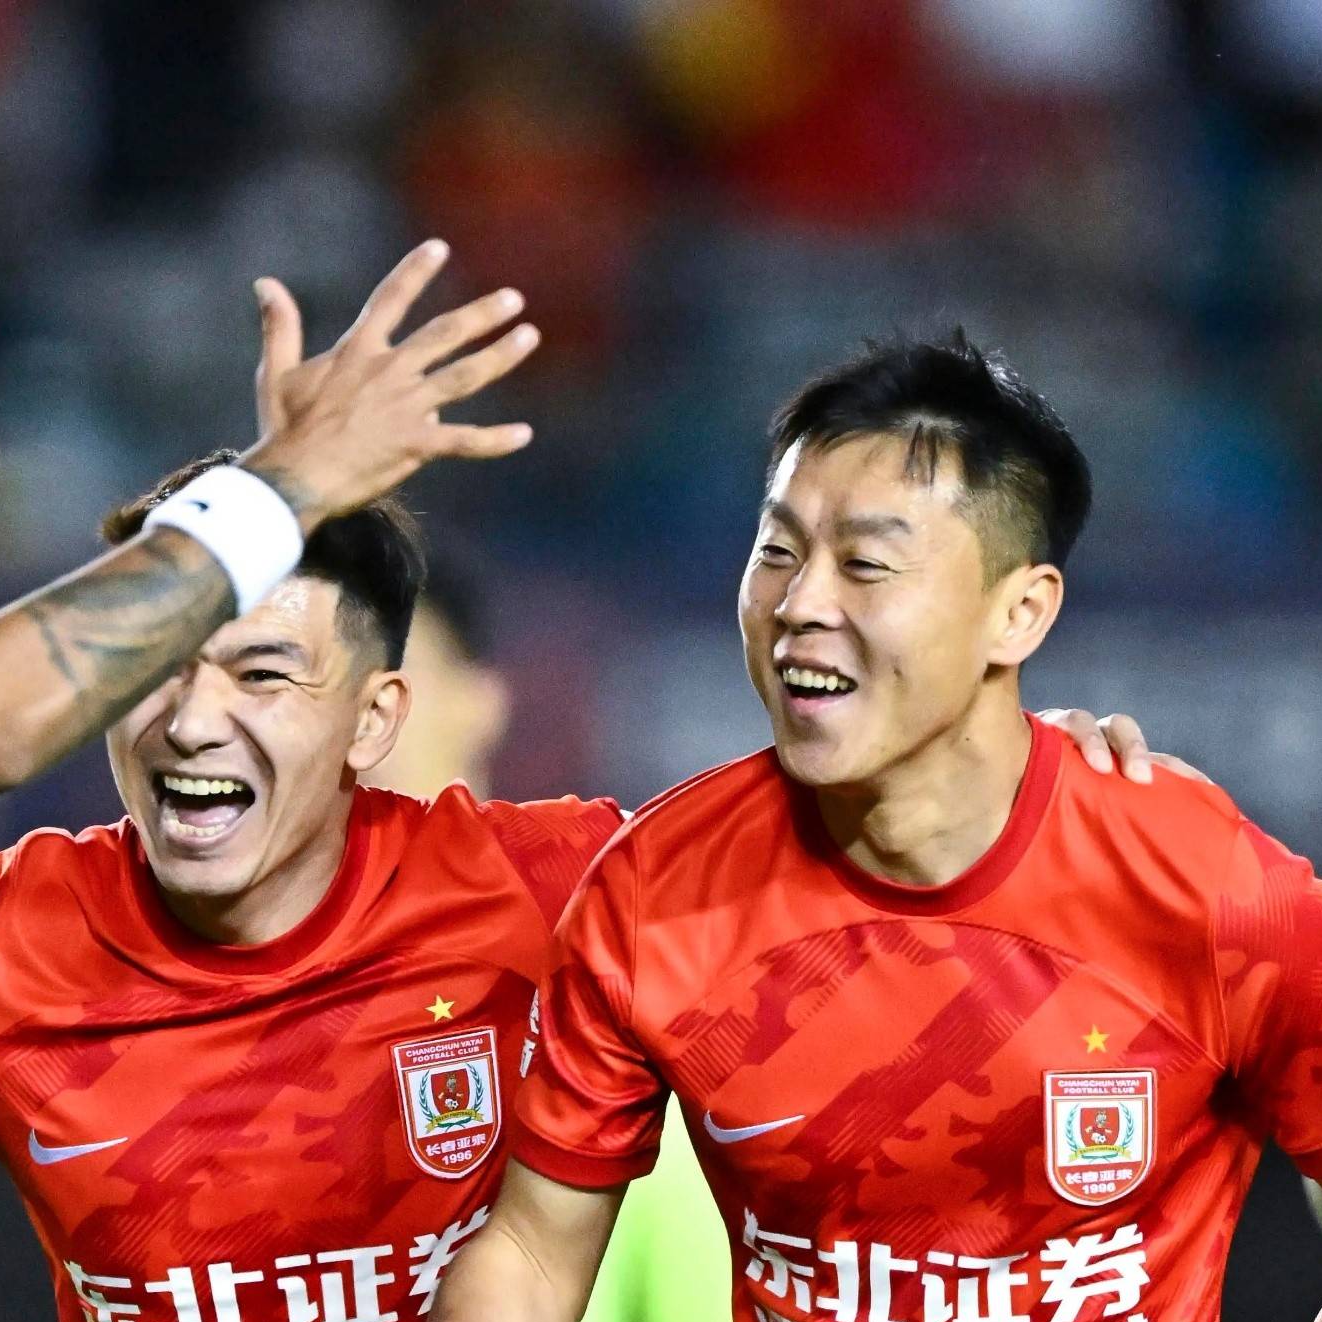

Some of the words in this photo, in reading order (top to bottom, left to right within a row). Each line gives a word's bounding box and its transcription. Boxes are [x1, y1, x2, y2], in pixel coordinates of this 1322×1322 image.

[406, 1041, 459, 1058] CHANGCHUN
[461, 1037, 484, 1048] YATAI
[413, 1050, 455, 1063] FOOTBALL
[458, 1046, 480, 1055] CLUB
[1058, 1079, 1114, 1087] CHANGCHUN
[426, 1133, 486, 1156] 长春亚泰
[442, 1150, 472, 1165] 1996
[1082, 1182, 1116, 1194] 1996
